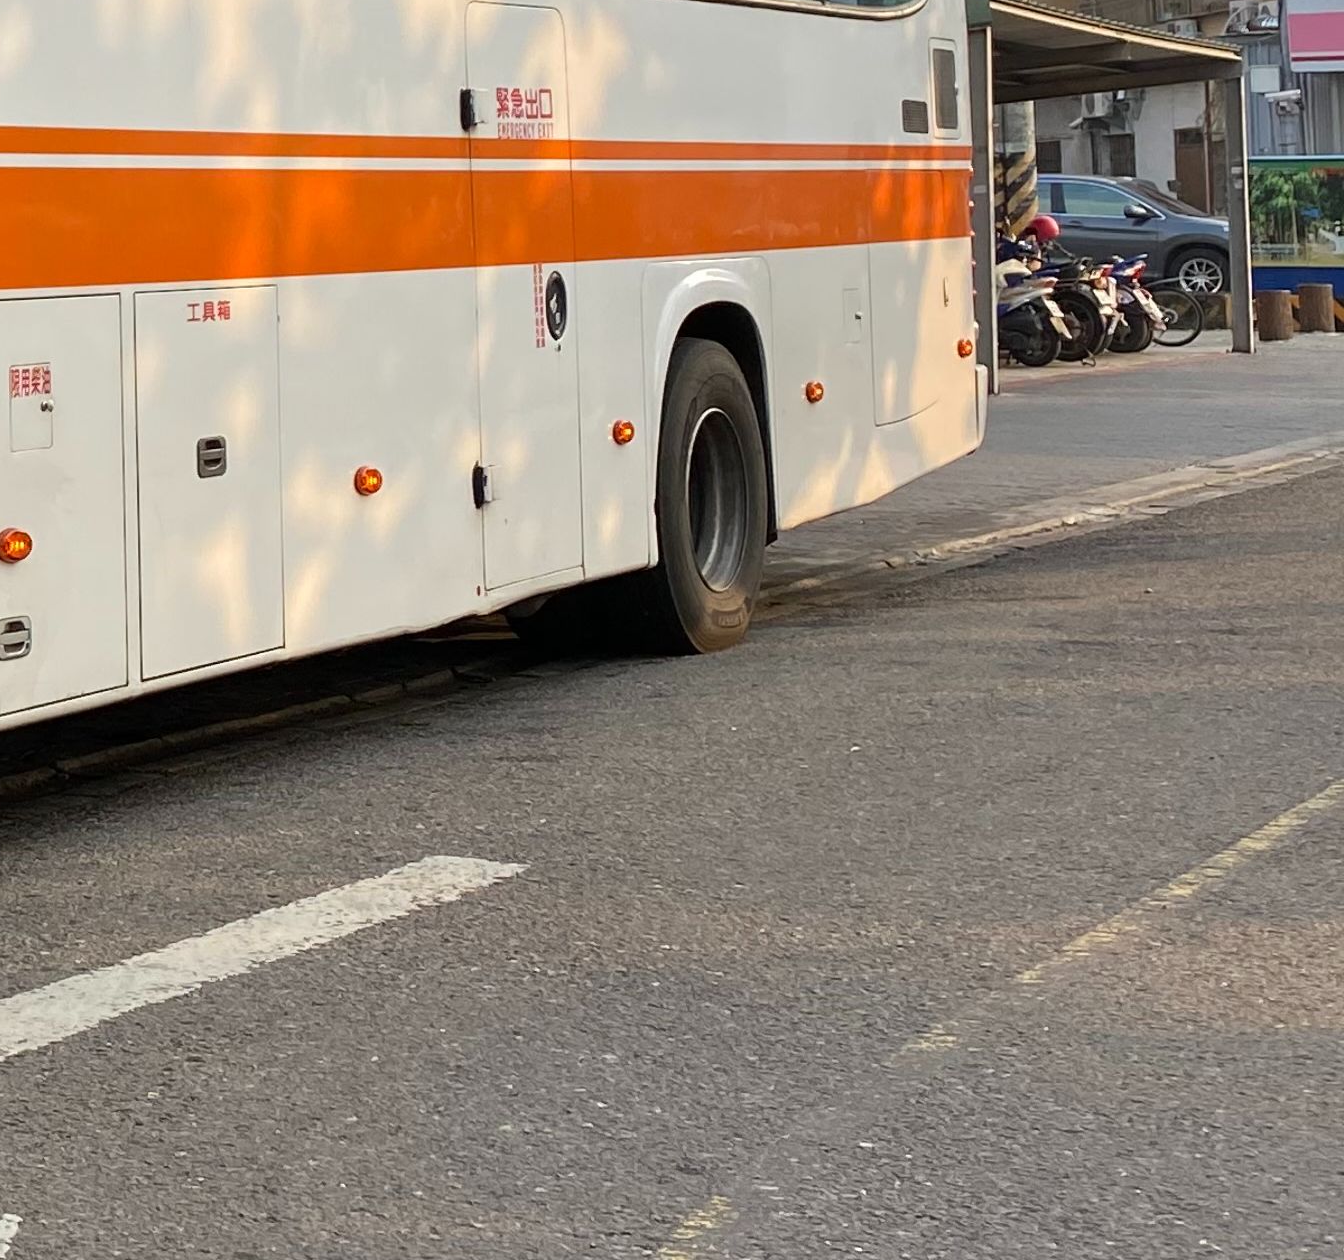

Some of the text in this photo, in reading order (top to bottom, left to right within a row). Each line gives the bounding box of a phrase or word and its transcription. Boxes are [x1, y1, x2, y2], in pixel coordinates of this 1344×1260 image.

[496, 87, 553, 119] 緊急出口
[497, 122, 554, 139] EMERGENCY EXIT
[186, 300, 231, 323] 工具箱
